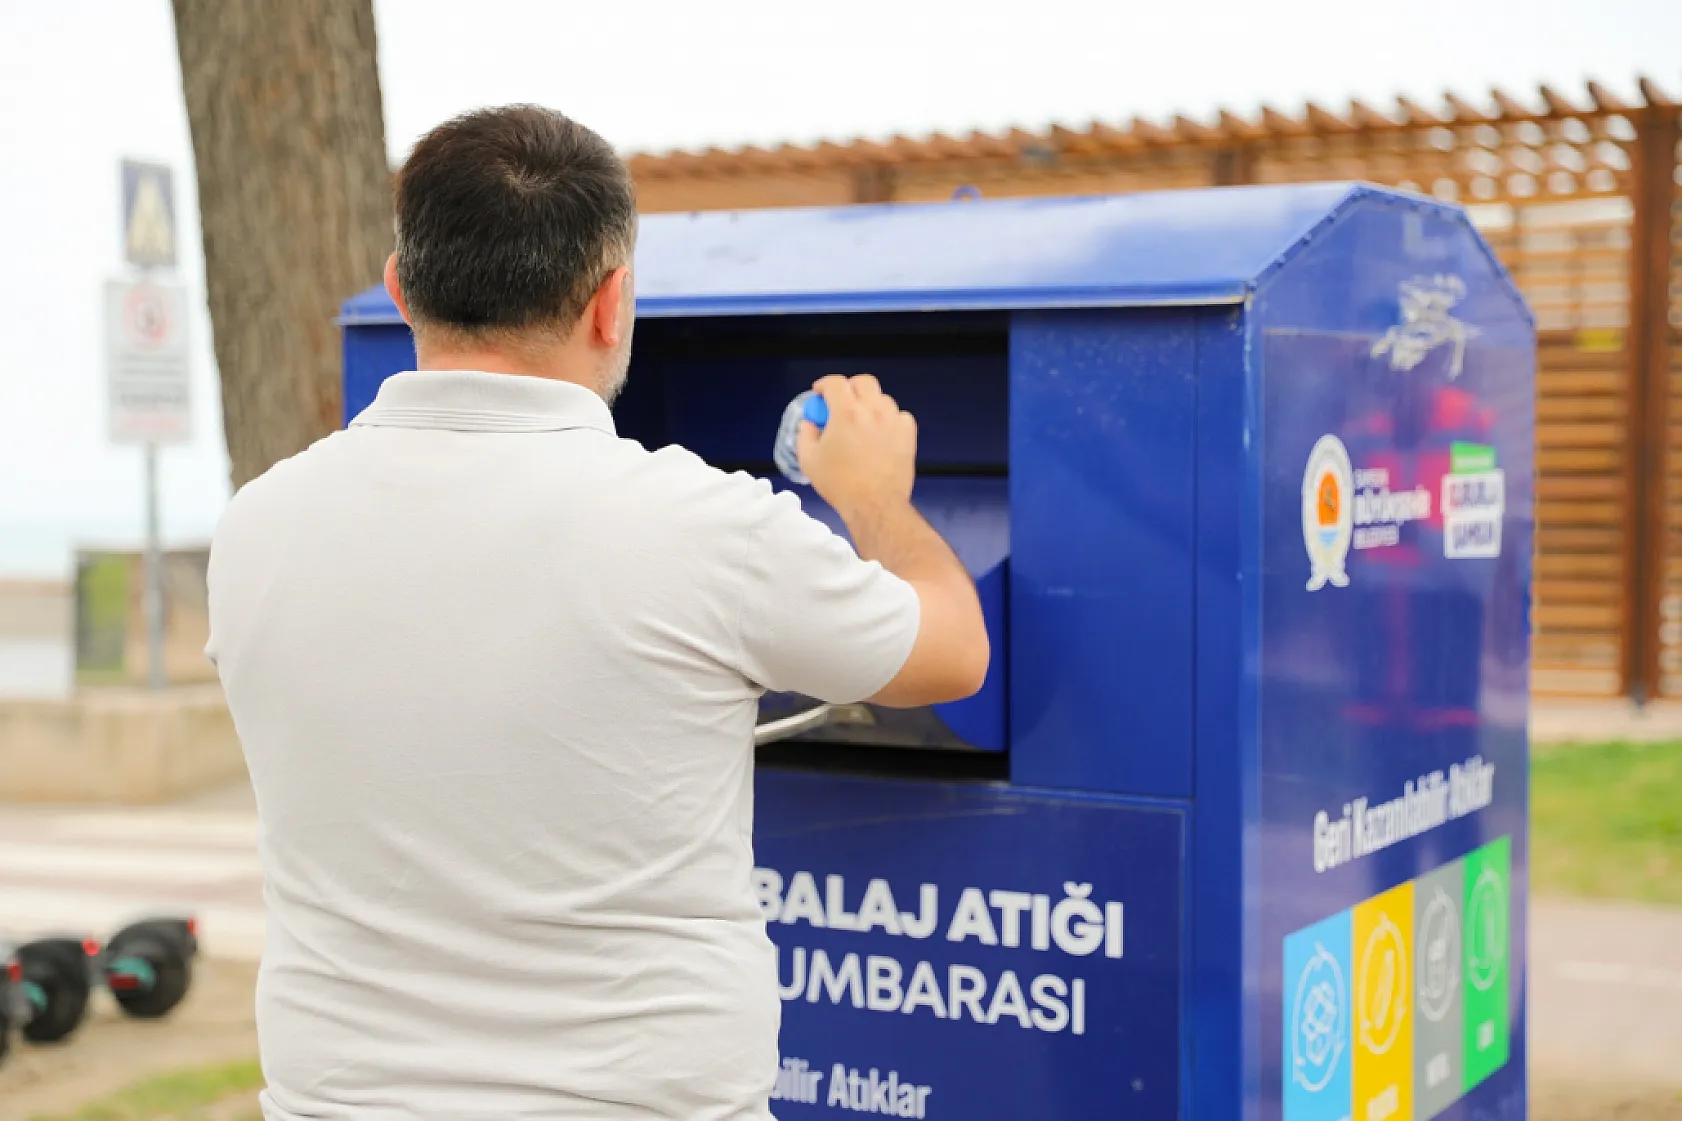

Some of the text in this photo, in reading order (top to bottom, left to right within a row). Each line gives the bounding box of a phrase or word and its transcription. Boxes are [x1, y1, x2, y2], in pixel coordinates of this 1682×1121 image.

[752, 867, 1123, 959] BALAJ ATIĞI
[776, 946, 1085, 1035] UMBARASI
[827, 1062, 932, 1119] Atıklar
